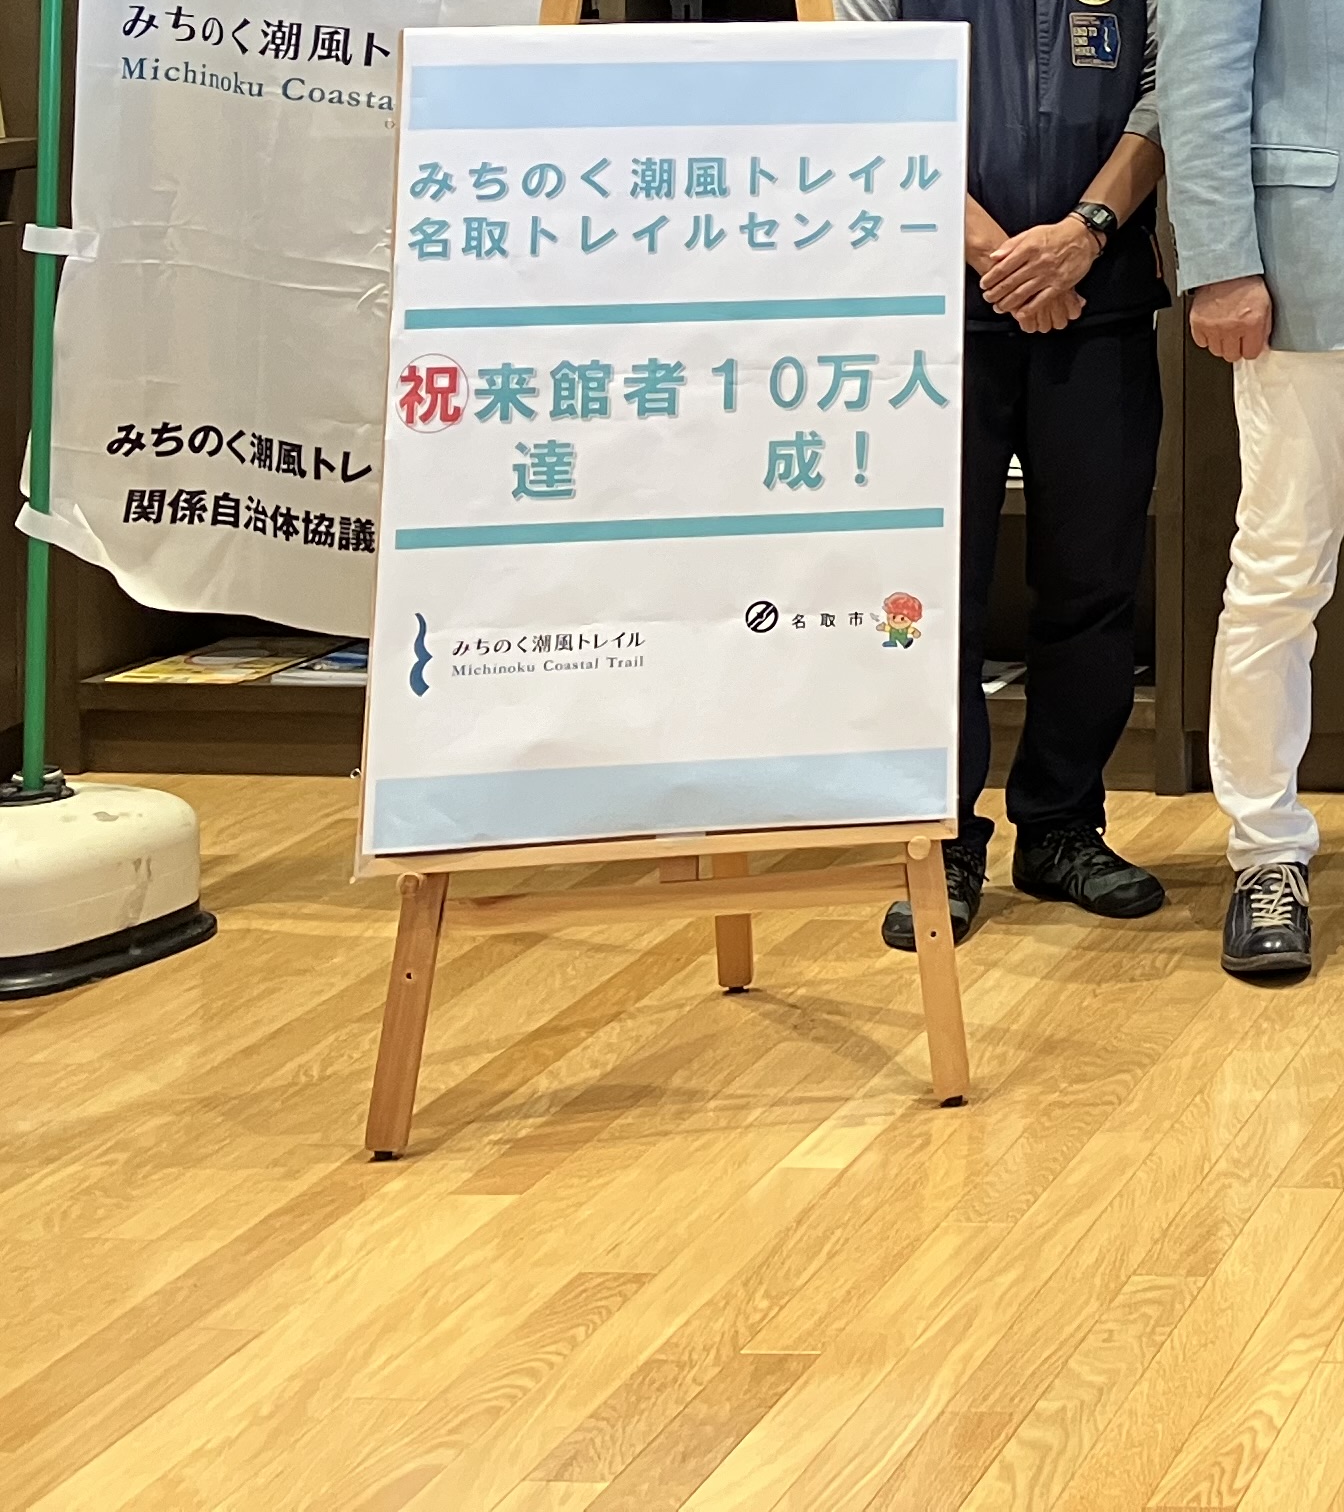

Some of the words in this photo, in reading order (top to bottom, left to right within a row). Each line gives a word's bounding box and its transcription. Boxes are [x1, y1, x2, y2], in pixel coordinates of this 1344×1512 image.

[121, 4, 392, 68] みちのく潮風ト
[120, 56, 264, 98] Michinoku
[408, 154, 942, 202] みちのく潮風トレイル
[406, 210, 940, 262] 名取トレイルセンター
[106, 421, 373, 484] みちのく潮風トレ
[122, 488, 377, 555] 関係自治体協議
[451, 631, 646, 658] みちのく潮風トレイル
[790, 610, 866, 631] 名取市
[451, 661, 536, 678] Michinoku
[542, 657, 600, 673] Coastal
[605, 654, 645, 670] Trail
